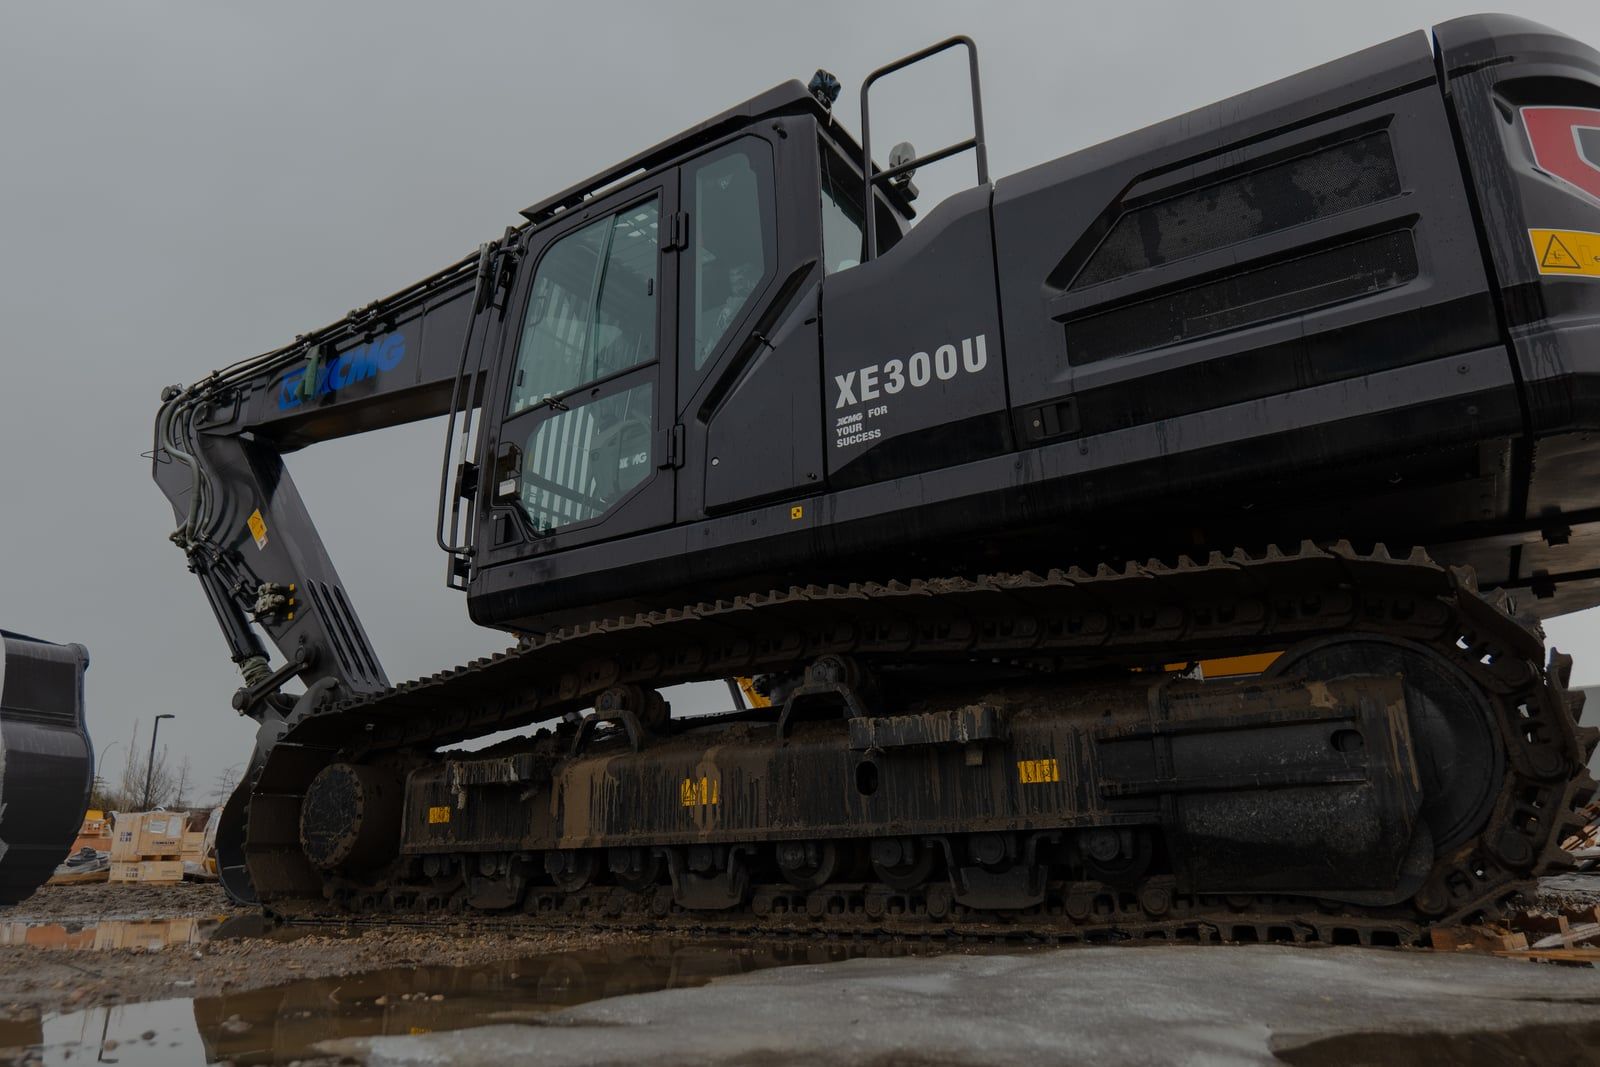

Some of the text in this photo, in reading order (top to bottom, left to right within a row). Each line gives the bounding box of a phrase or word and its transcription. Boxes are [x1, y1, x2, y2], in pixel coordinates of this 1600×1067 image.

[834, 334, 988, 410] XE300U
[836, 405, 888, 427] XCMG FOR
[836, 423, 863, 437] YOUR
[836, 429, 882, 448] SUCCESS
